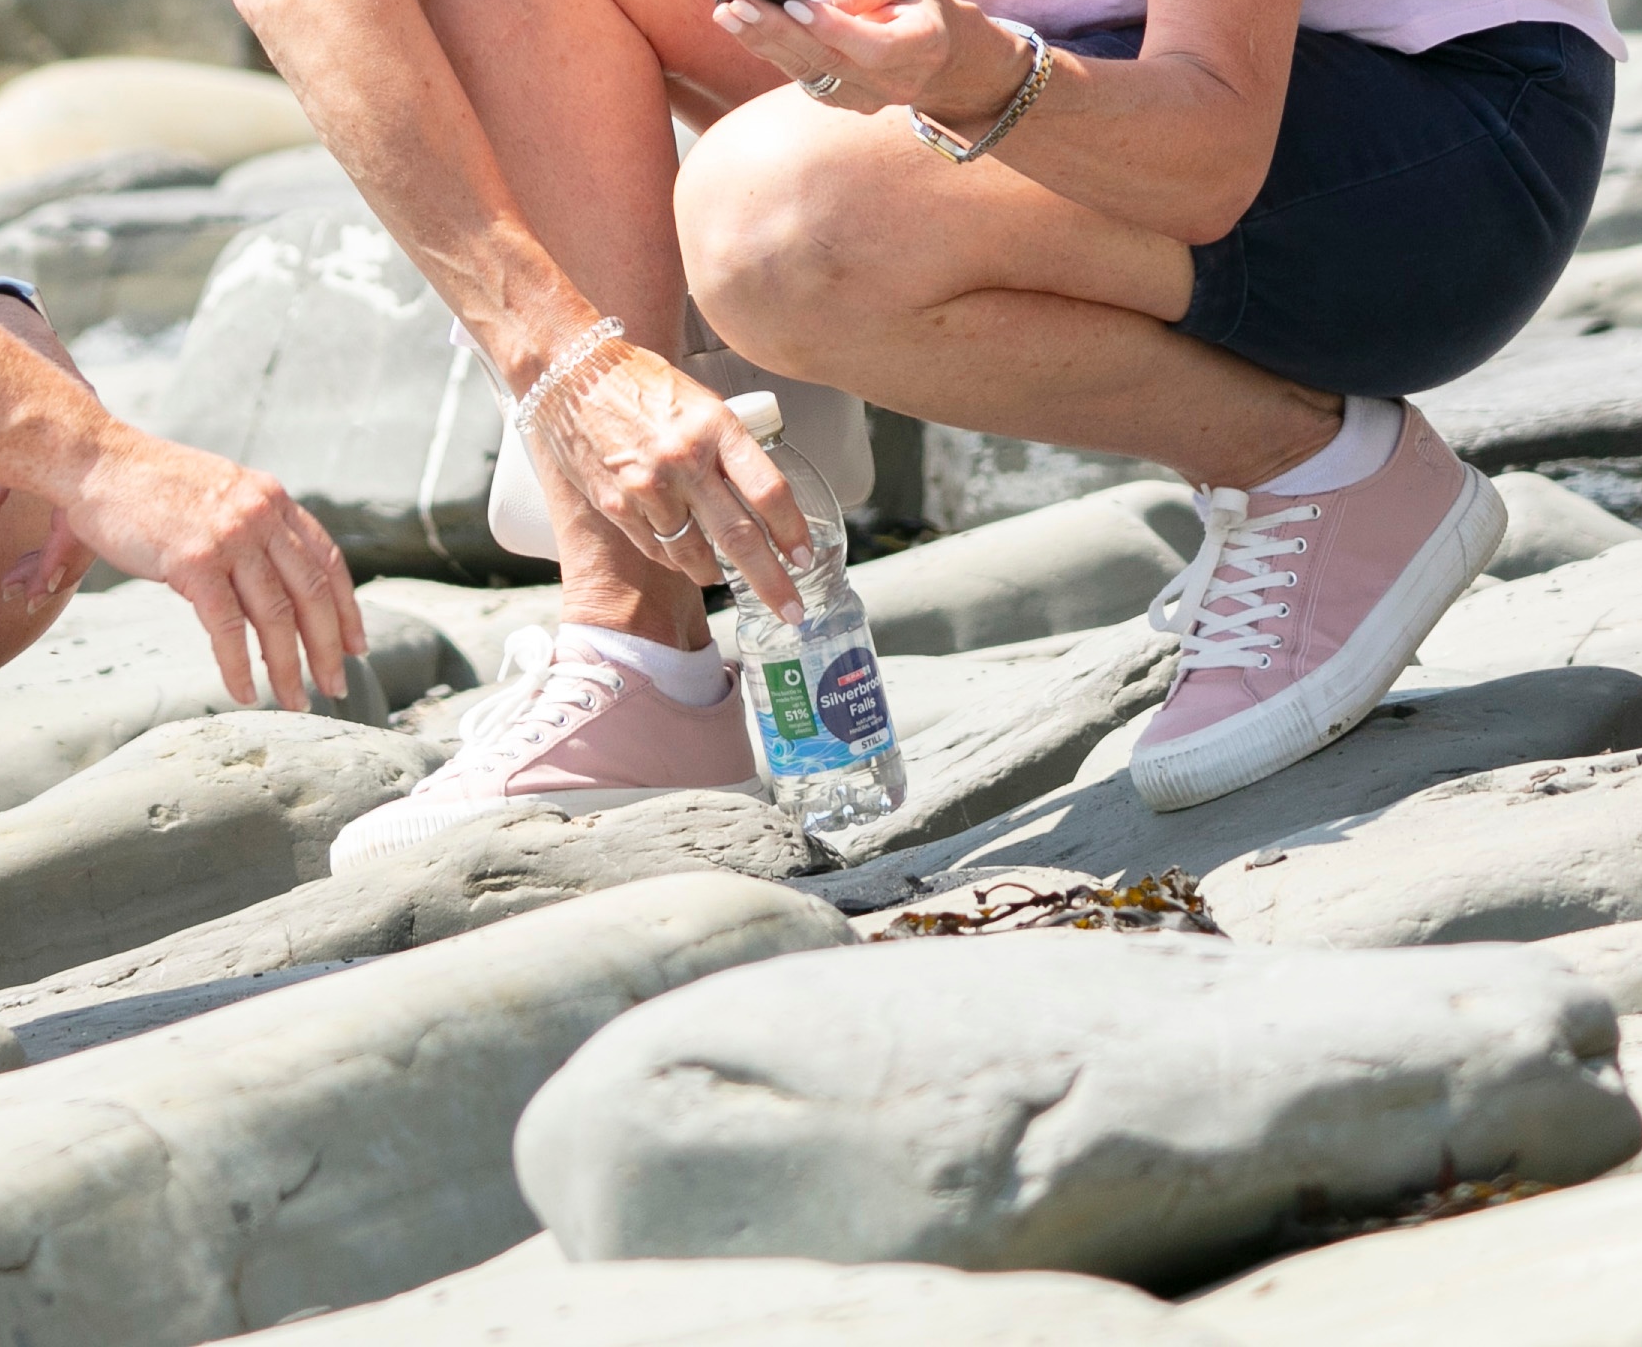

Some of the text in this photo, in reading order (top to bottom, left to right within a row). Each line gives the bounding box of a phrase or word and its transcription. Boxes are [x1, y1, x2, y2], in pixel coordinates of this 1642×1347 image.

[820, 676, 881, 708] Silverbroo
[785, 707, 809, 721] 51%
[849, 697, 876, 717] Falls
[861, 734, 883, 750] STILL
